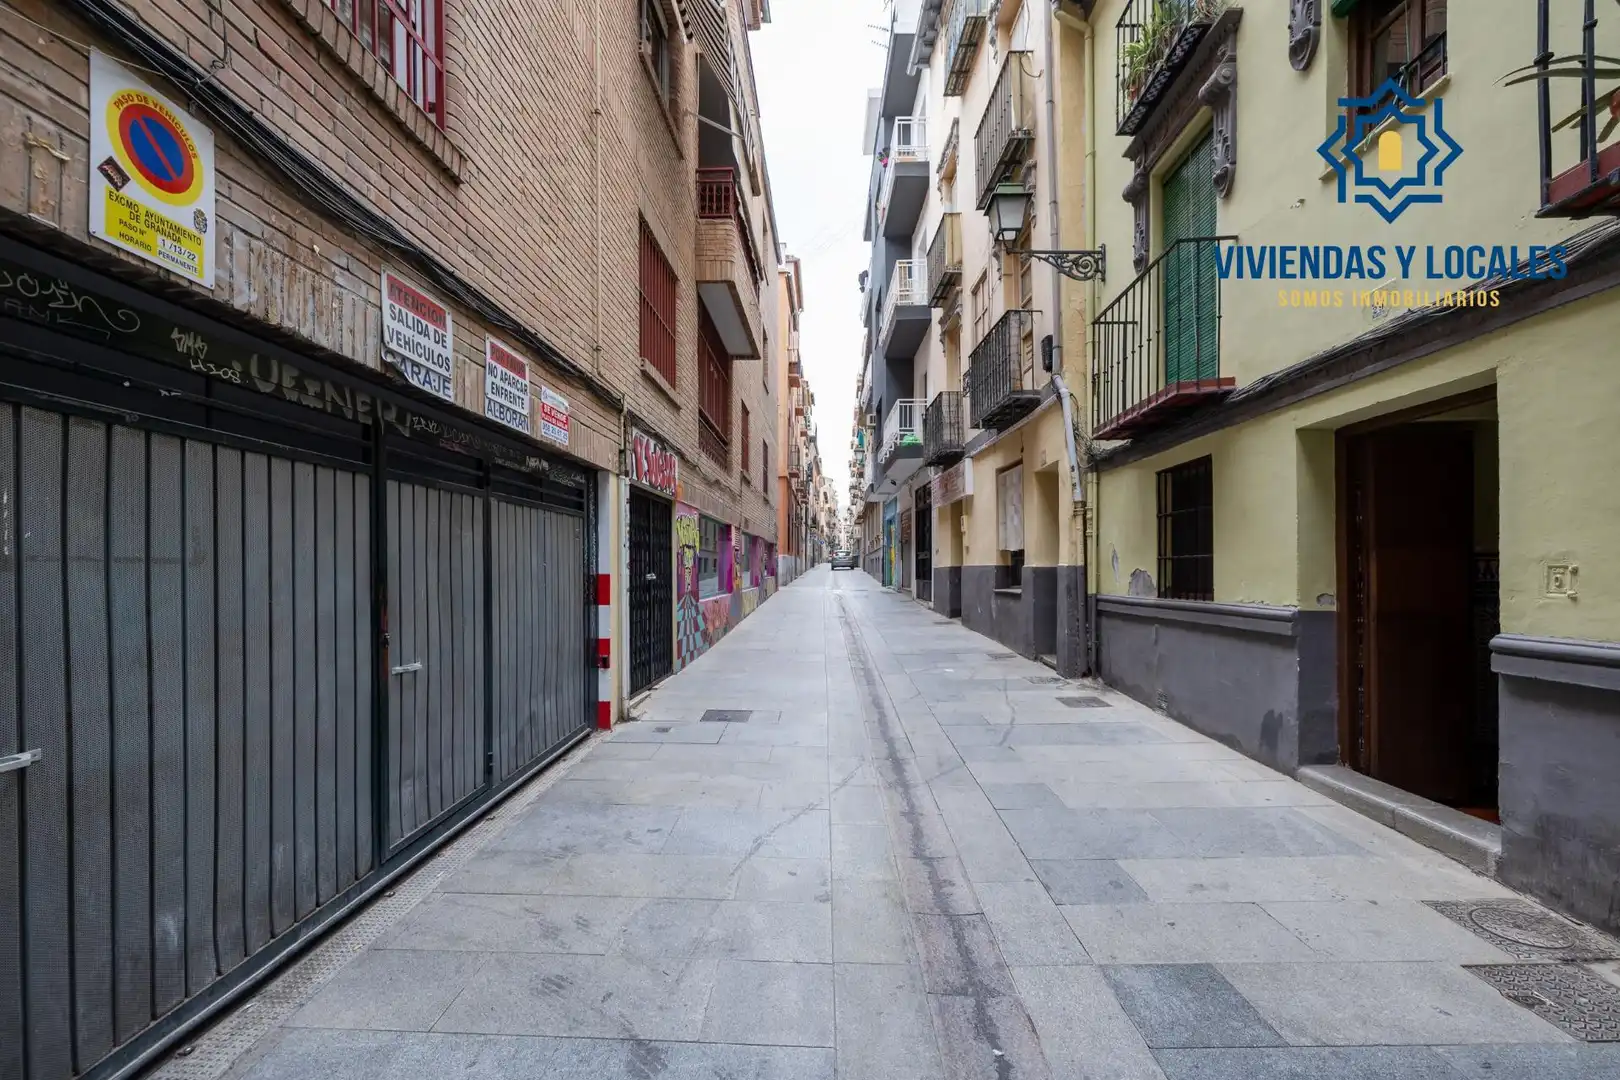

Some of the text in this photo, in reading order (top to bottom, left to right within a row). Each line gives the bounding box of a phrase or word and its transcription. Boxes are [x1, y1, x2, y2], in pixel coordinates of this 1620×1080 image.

[113, 93, 134, 110] PASO
[136, 94, 149, 105] DE
[108, 190, 202, 246] EXCMO. AYUNTAMIENTO
[119, 218, 137, 233] PASO
[129, 211, 182, 244] DE GRANADA
[119, 232, 152, 252] HORARIO
[158, 250, 198, 273] PERMANENTE
[389, 303, 448, 349] SALIDA DE
[387, 324, 451, 373] VEHÍCULOS
[488, 362, 529, 396] NO APARCAR
[491, 381, 525, 410] ENFRENTE
[487, 399, 529, 432] ALBORAN
[543, 404, 567, 423] SE VENDE
